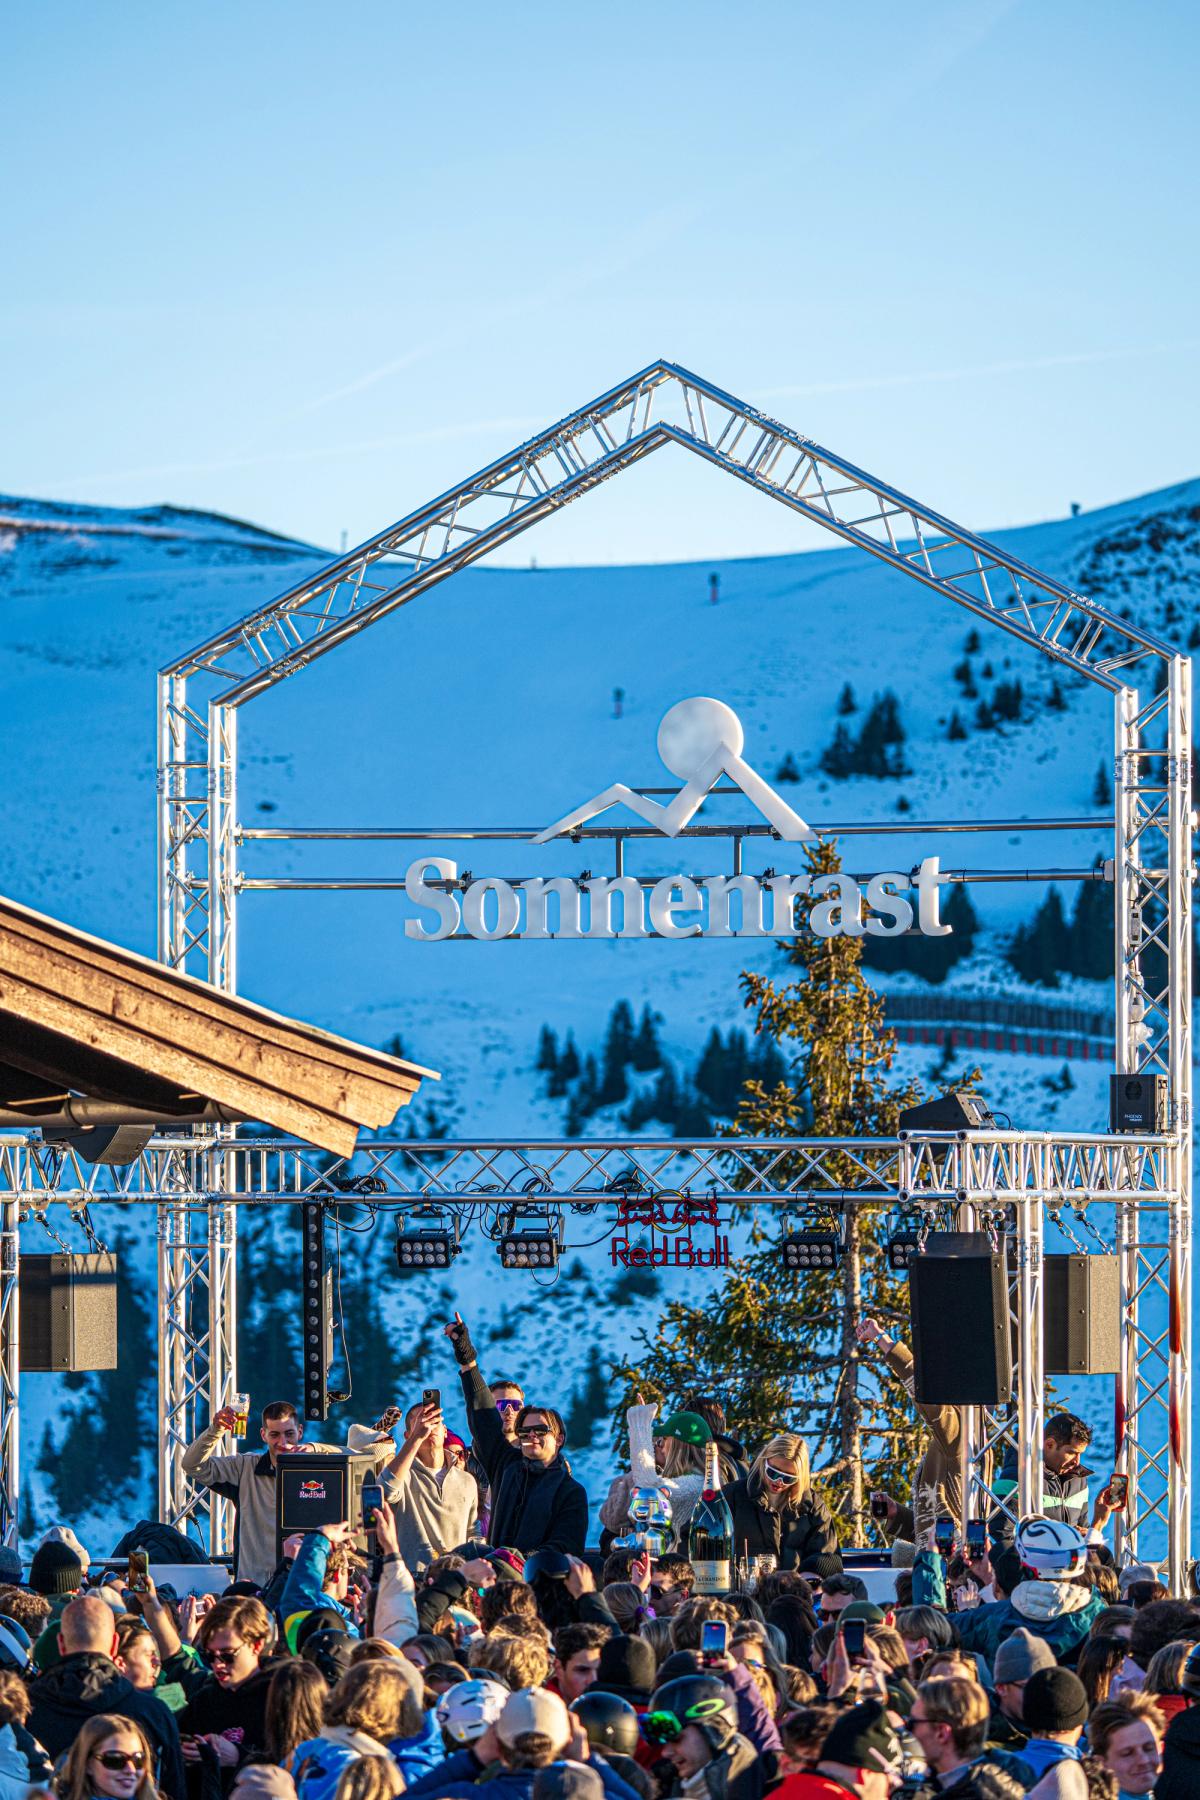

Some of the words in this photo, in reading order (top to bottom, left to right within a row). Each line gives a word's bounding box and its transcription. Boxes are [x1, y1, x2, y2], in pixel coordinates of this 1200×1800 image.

[404, 856, 954, 941] Sonnenrast
[611, 1235, 668, 1267] Red
[675, 1235, 729, 1267] Bull
[299, 1490, 312, 1499] Red
[312, 1490, 326, 1499] Bull
